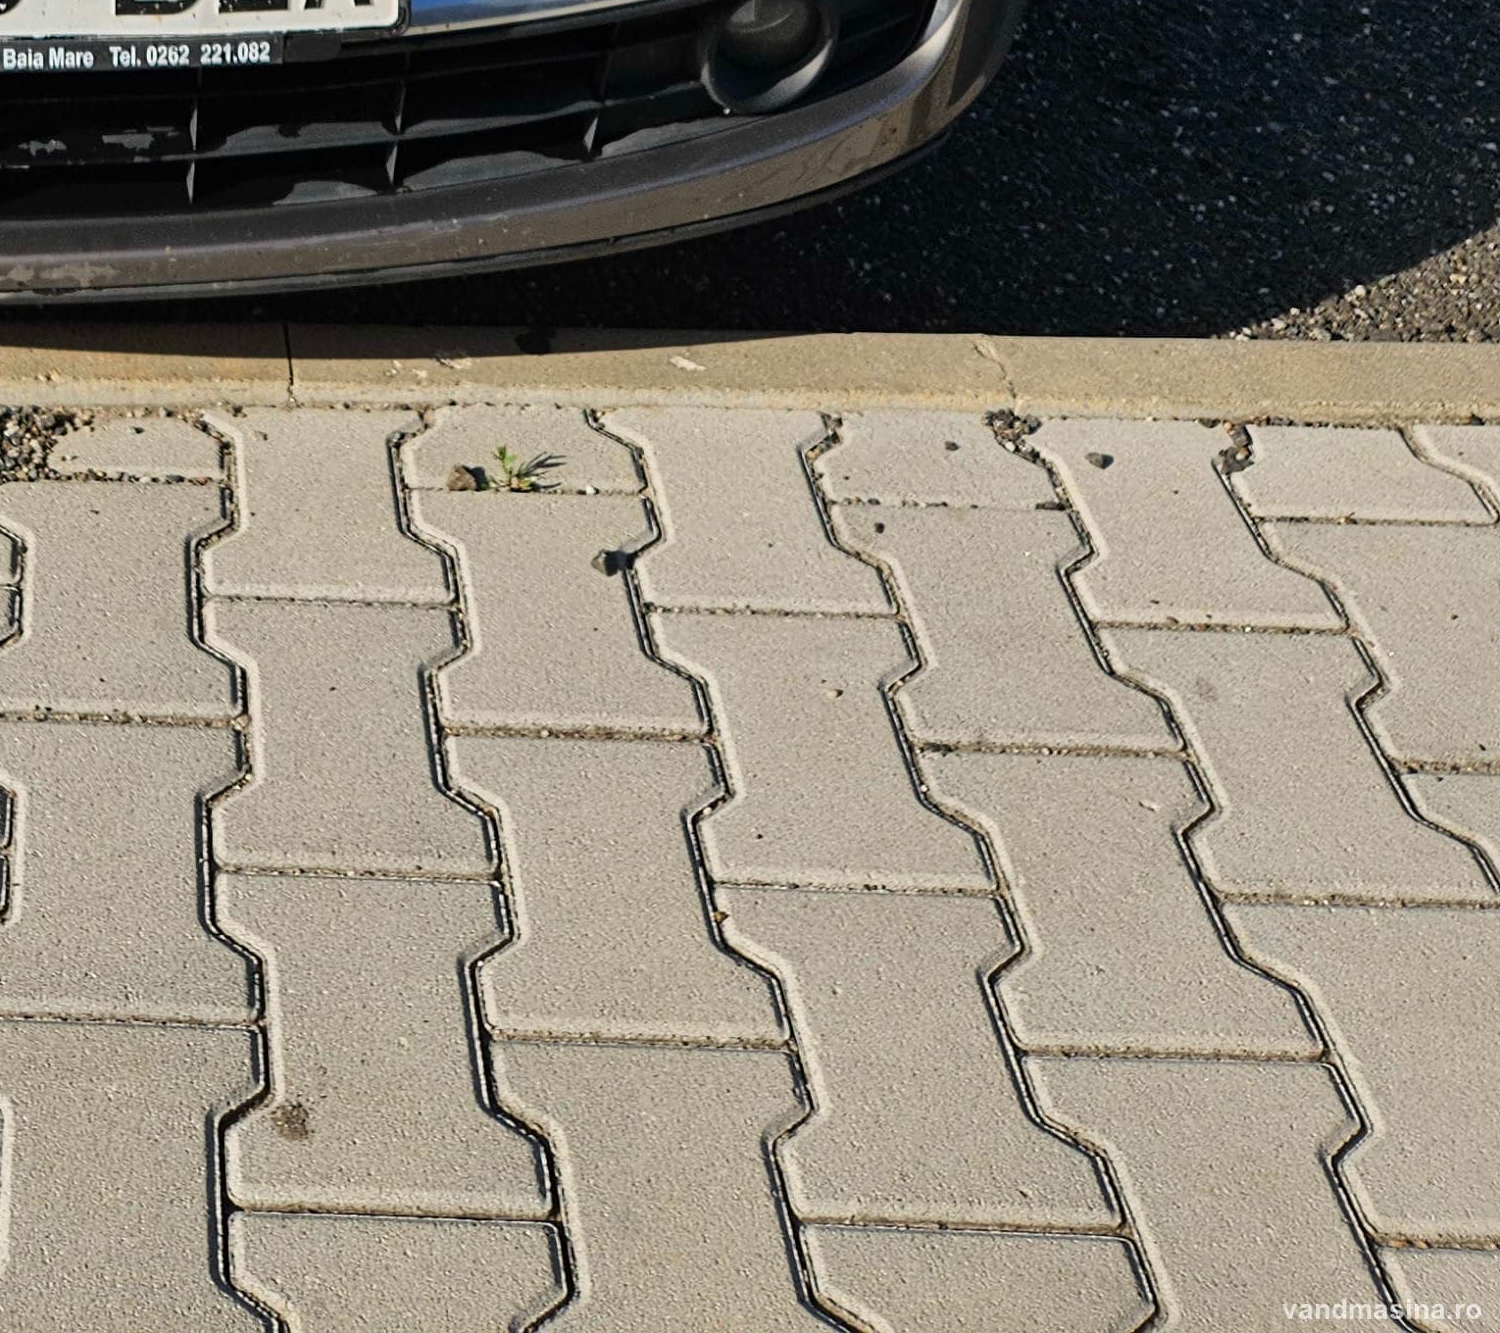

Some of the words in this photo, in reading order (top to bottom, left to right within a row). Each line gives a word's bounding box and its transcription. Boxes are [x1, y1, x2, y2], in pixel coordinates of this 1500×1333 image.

[3, 48, 44, 70] Baia
[49, 47, 94, 69] Mare
[109, 45, 141, 67] Tel.
[146, 44, 190, 66] 0262
[200, 41, 270, 65] 221.082
